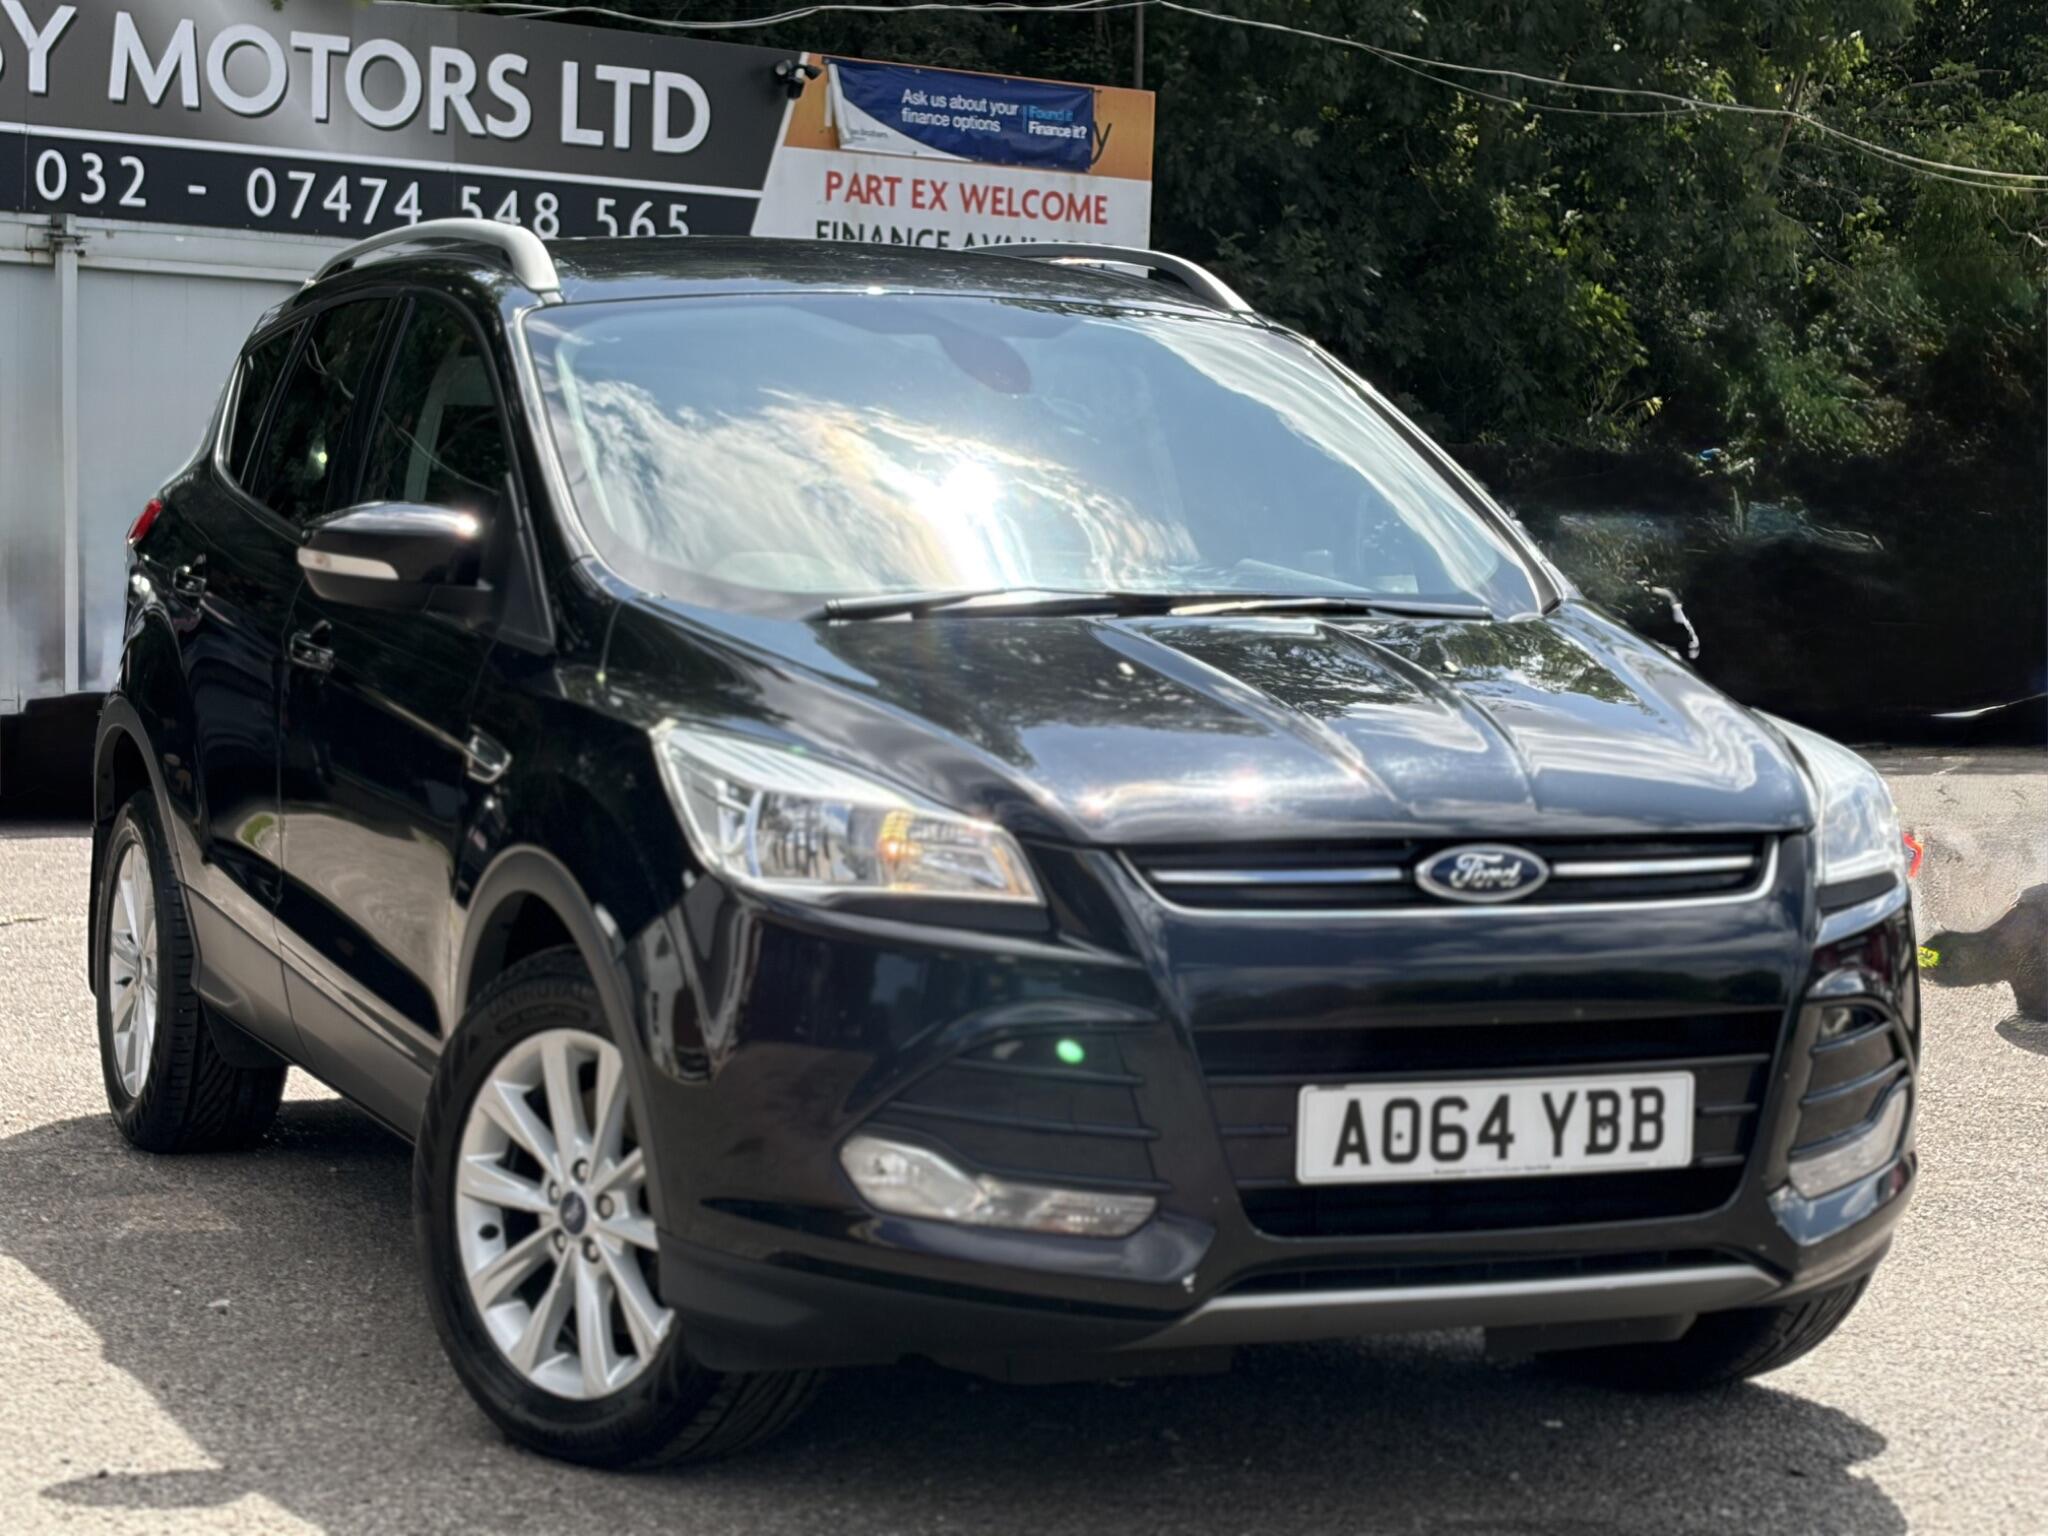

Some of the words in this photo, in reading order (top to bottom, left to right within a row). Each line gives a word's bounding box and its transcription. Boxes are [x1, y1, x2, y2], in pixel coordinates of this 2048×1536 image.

[108, 11, 533, 138] MOTORS
[561, 60, 711, 153] LTD
[902, 88, 928, 106] Ask
[930, 94, 947, 108] us
[949, 95, 987, 113] about
[989, 102, 1019, 117] your
[901, 108, 949, 127] finance
[952, 112, 1001, 132] options
[1028, 121, 1071, 137] Finance
[35, 149, 147, 207] 032
[246, 167, 422, 226] 07474
[461, 186, 560, 238] 548
[597, 197, 689, 237] 565
[825, 170, 902, 207] PART
[911, 178, 949, 212] EX
[959, 182, 1108, 225] WELCOME
[1449, 852, 1522, 889] Ford
[1541, 1086, 1666, 1158] YBB
